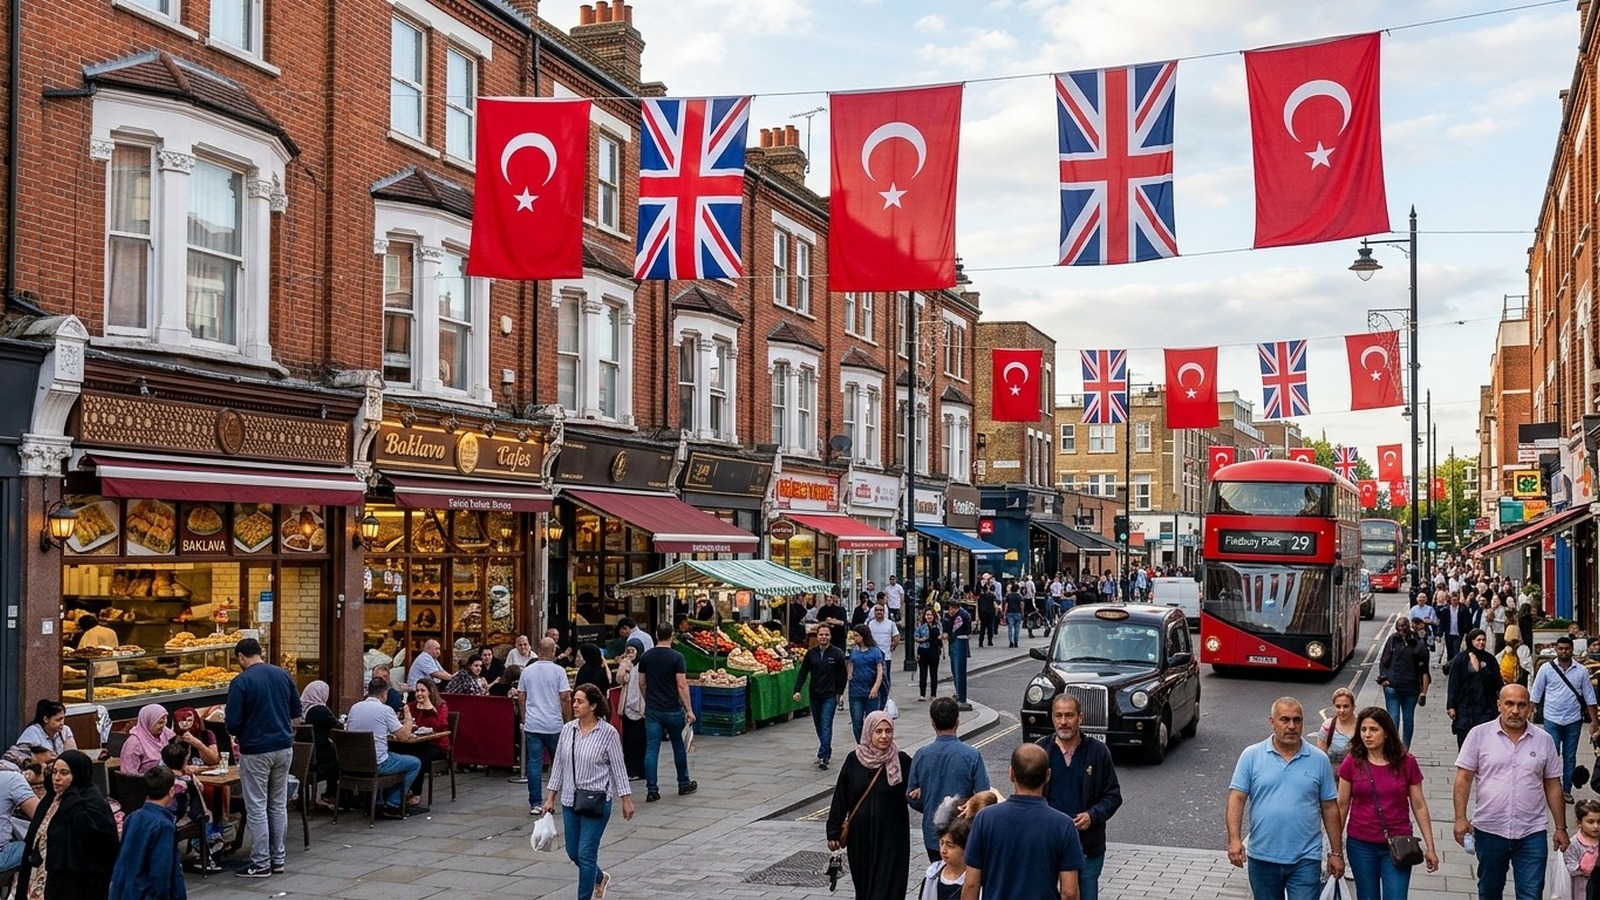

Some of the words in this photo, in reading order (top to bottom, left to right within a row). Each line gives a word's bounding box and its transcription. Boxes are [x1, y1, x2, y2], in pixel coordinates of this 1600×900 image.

[497, 446, 531, 471] Cafes
[182, 539, 226, 551] BAKLAVA
[1291, 535, 1310, 550] 29
